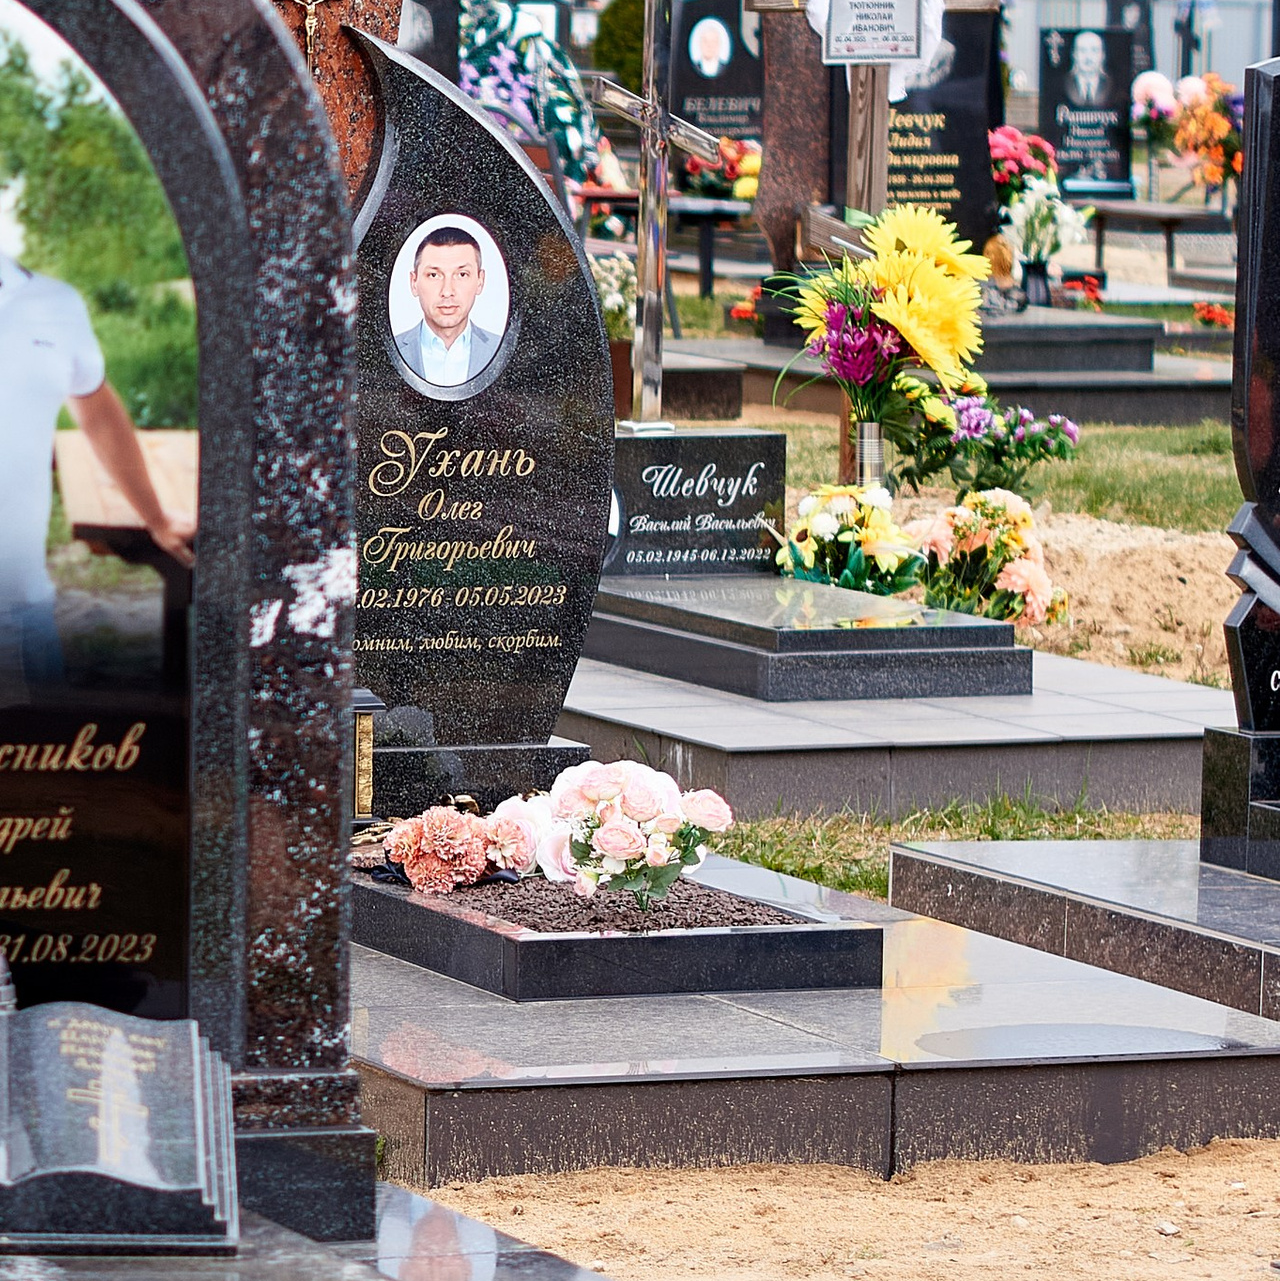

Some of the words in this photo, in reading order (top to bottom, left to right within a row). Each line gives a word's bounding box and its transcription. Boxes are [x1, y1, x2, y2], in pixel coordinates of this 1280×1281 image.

[369, 427, 535, 496] Ухань
[642, 462, 765, 506] Шевчук
[417, 488, 483, 520] Олег
[629, 513, 691, 534] Василий
[363, 524, 536, 572] Григорьевич
[355, 585, 568, 608] .02.1976-05.05.2023
[352, 635, 414, 652] омним,
[419, 630, 483, 651] любим,
[487, 628, 563, 653] скорбим.
